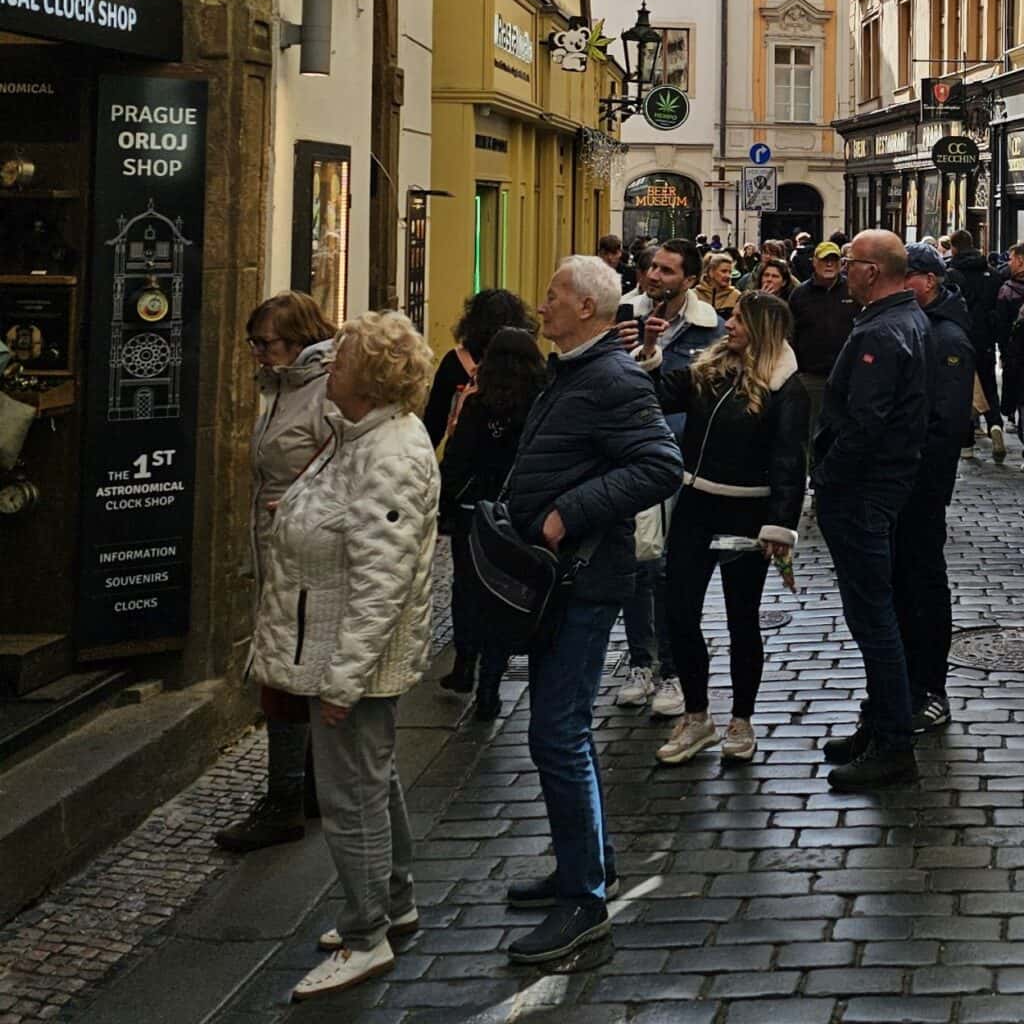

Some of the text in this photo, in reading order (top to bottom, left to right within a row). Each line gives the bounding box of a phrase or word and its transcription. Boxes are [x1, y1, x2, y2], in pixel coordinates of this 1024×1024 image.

[98, 0, 137, 32] SHOP
[111, 105, 197, 125] PRAGUE
[118, 132, 188, 150] ORLOJ
[123, 159, 182, 176] SHOP
[647, 186, 676, 196] BEER
[635, 196, 688, 207] MUSEUM
[108, 450, 176, 481] THE 1ST
[96, 480, 184, 498] ASTRONOMICAL
[105, 495, 174, 511] CLOCK SHOP
[99, 545, 176, 563] INFORMATION
[105, 571, 169, 588] SOUVENIRS
[114, 597, 158, 613] CLOCKS
